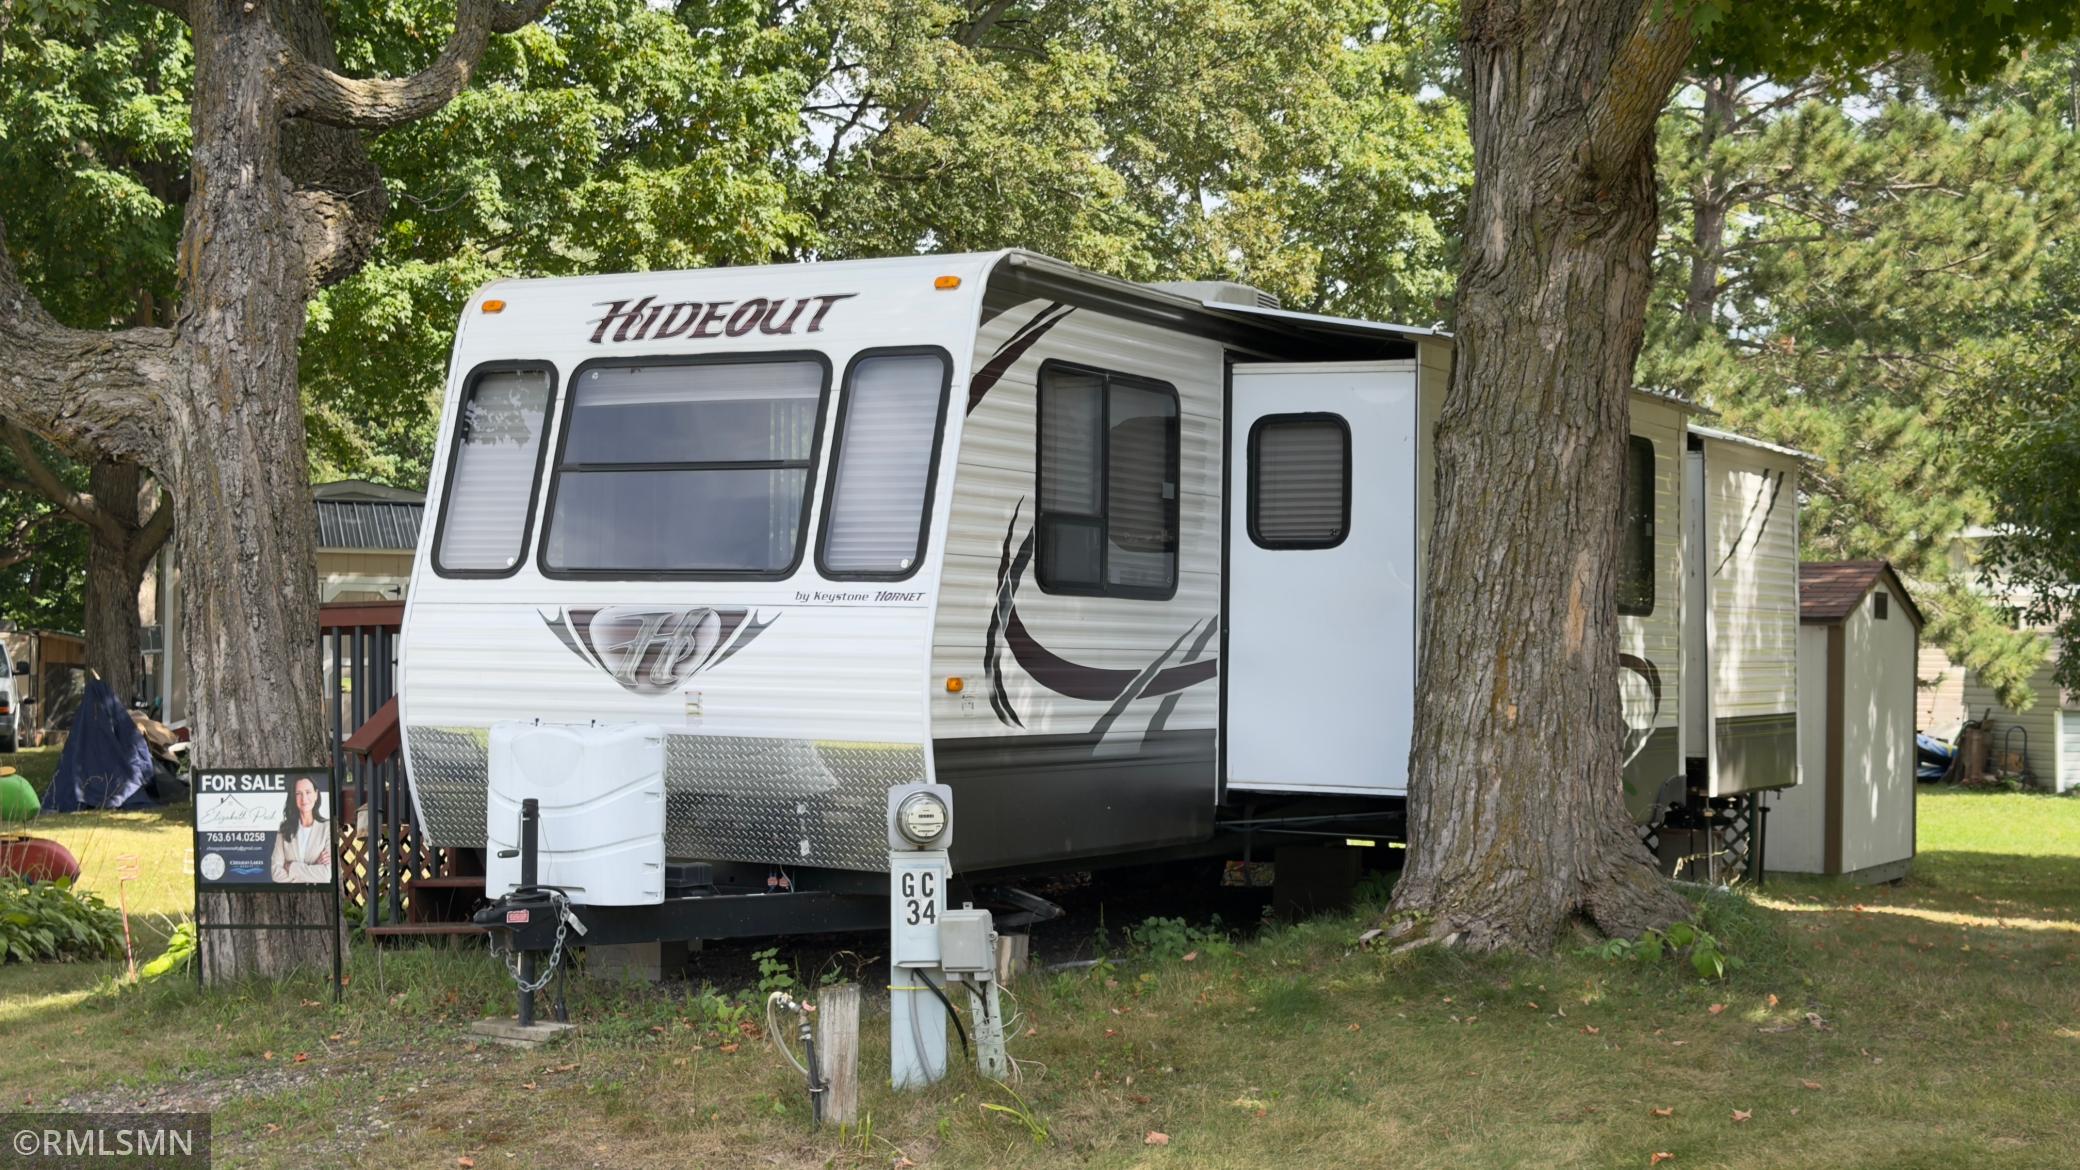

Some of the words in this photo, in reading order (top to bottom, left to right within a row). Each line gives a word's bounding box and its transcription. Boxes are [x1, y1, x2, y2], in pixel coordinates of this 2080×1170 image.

[587, 292, 860, 344] HIDEOUT
[795, 591, 810, 604] by
[813, 591, 870, 604] Keystone
[874, 590, 927, 602] HORNET
[201, 774, 237, 792] FOR
[240, 774, 286, 791] SALE
[206, 832, 266, 842] 763.614.0258
[906, 899, 936, 925] 34
